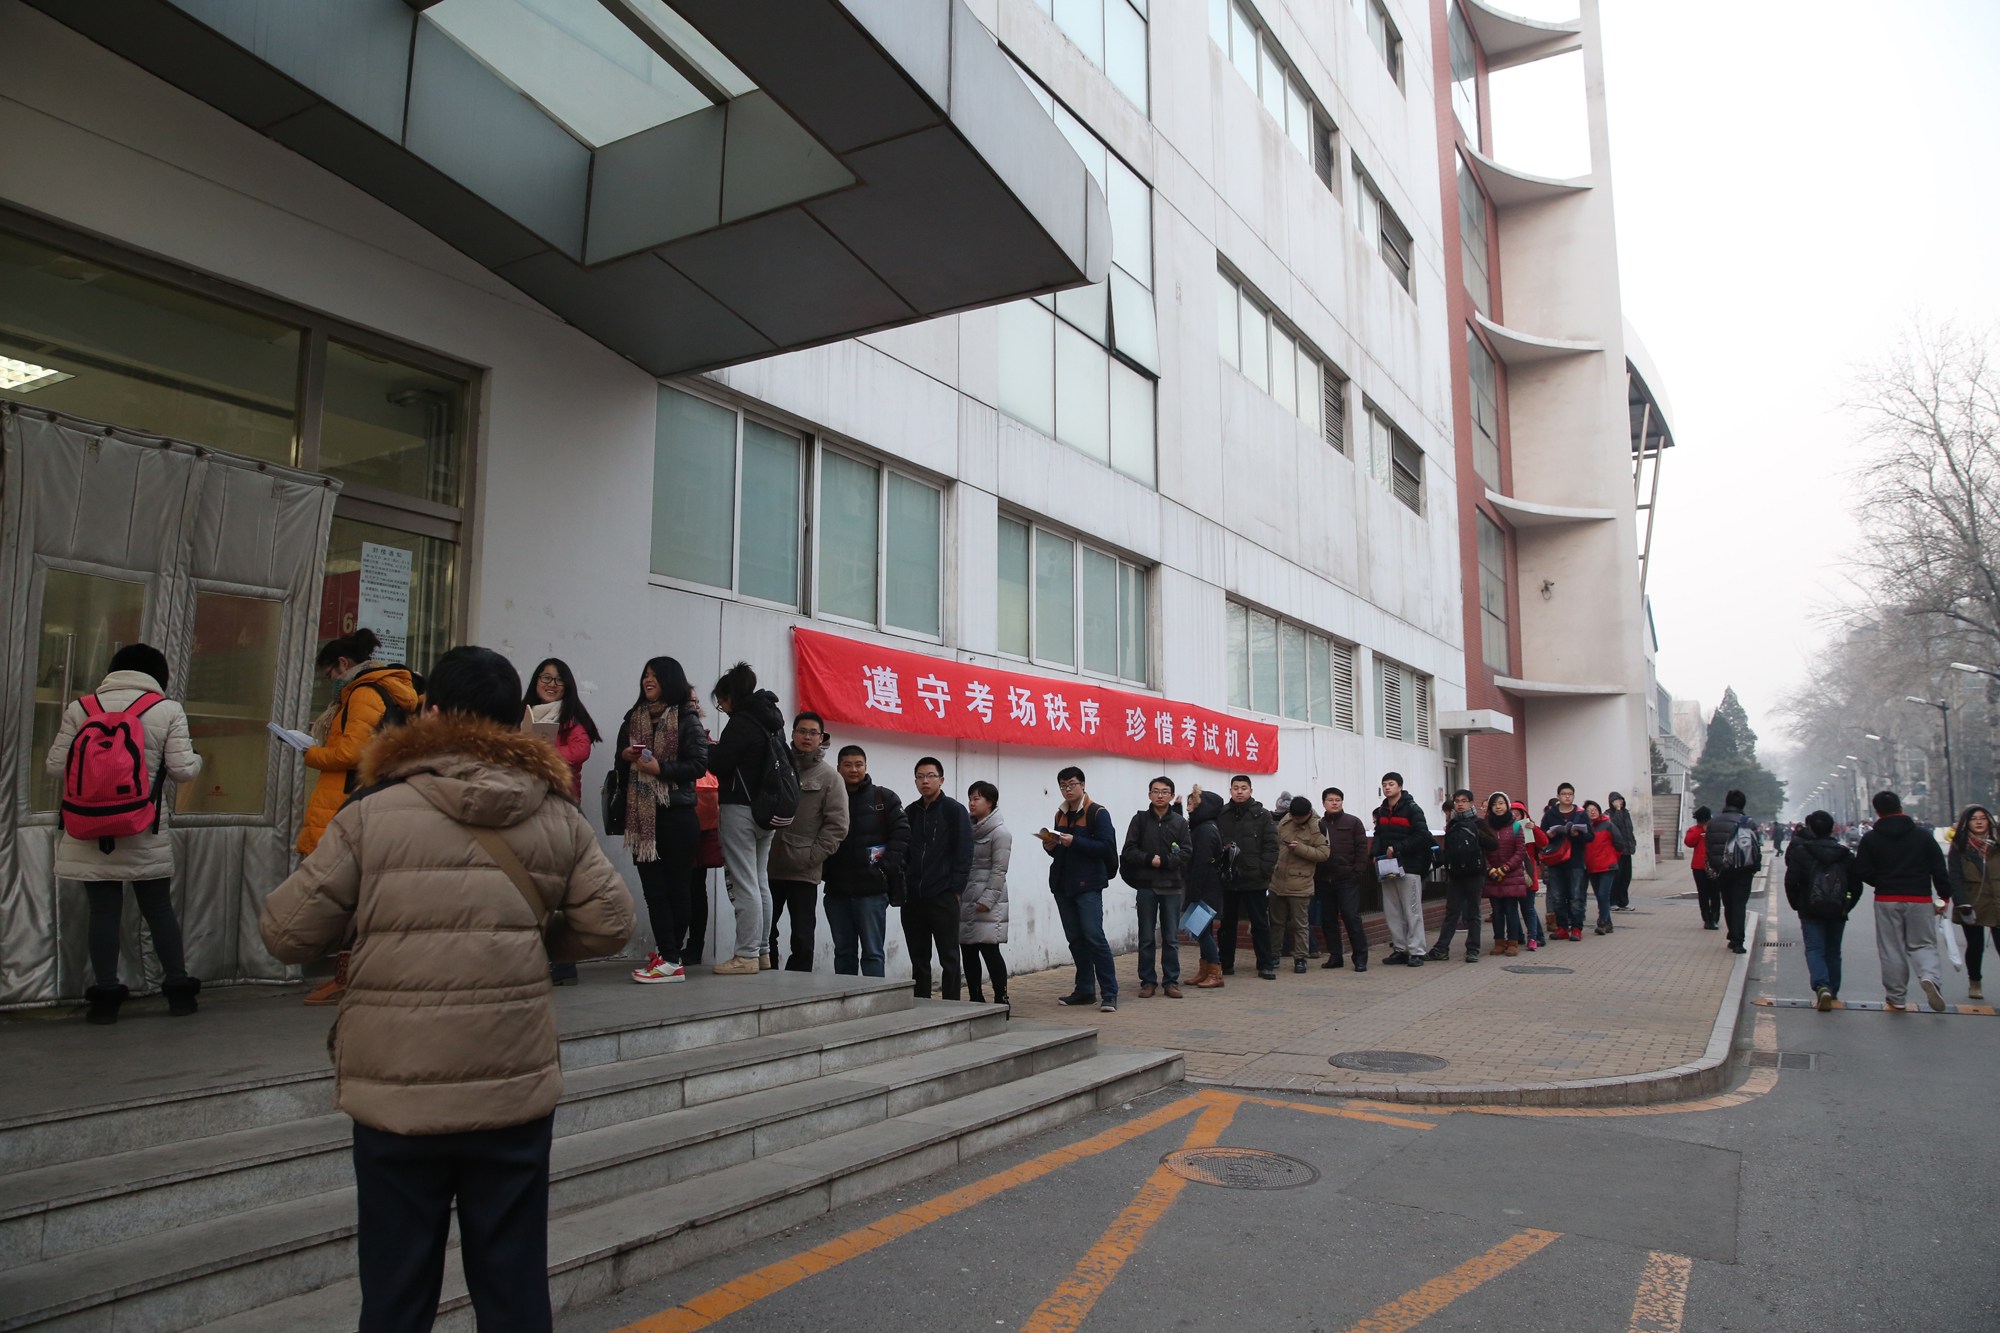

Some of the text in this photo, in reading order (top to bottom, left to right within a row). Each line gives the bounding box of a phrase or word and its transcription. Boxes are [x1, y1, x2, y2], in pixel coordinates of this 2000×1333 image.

[863, 665, 1259, 761] 遵守考场秩序 珍惜考试机会
